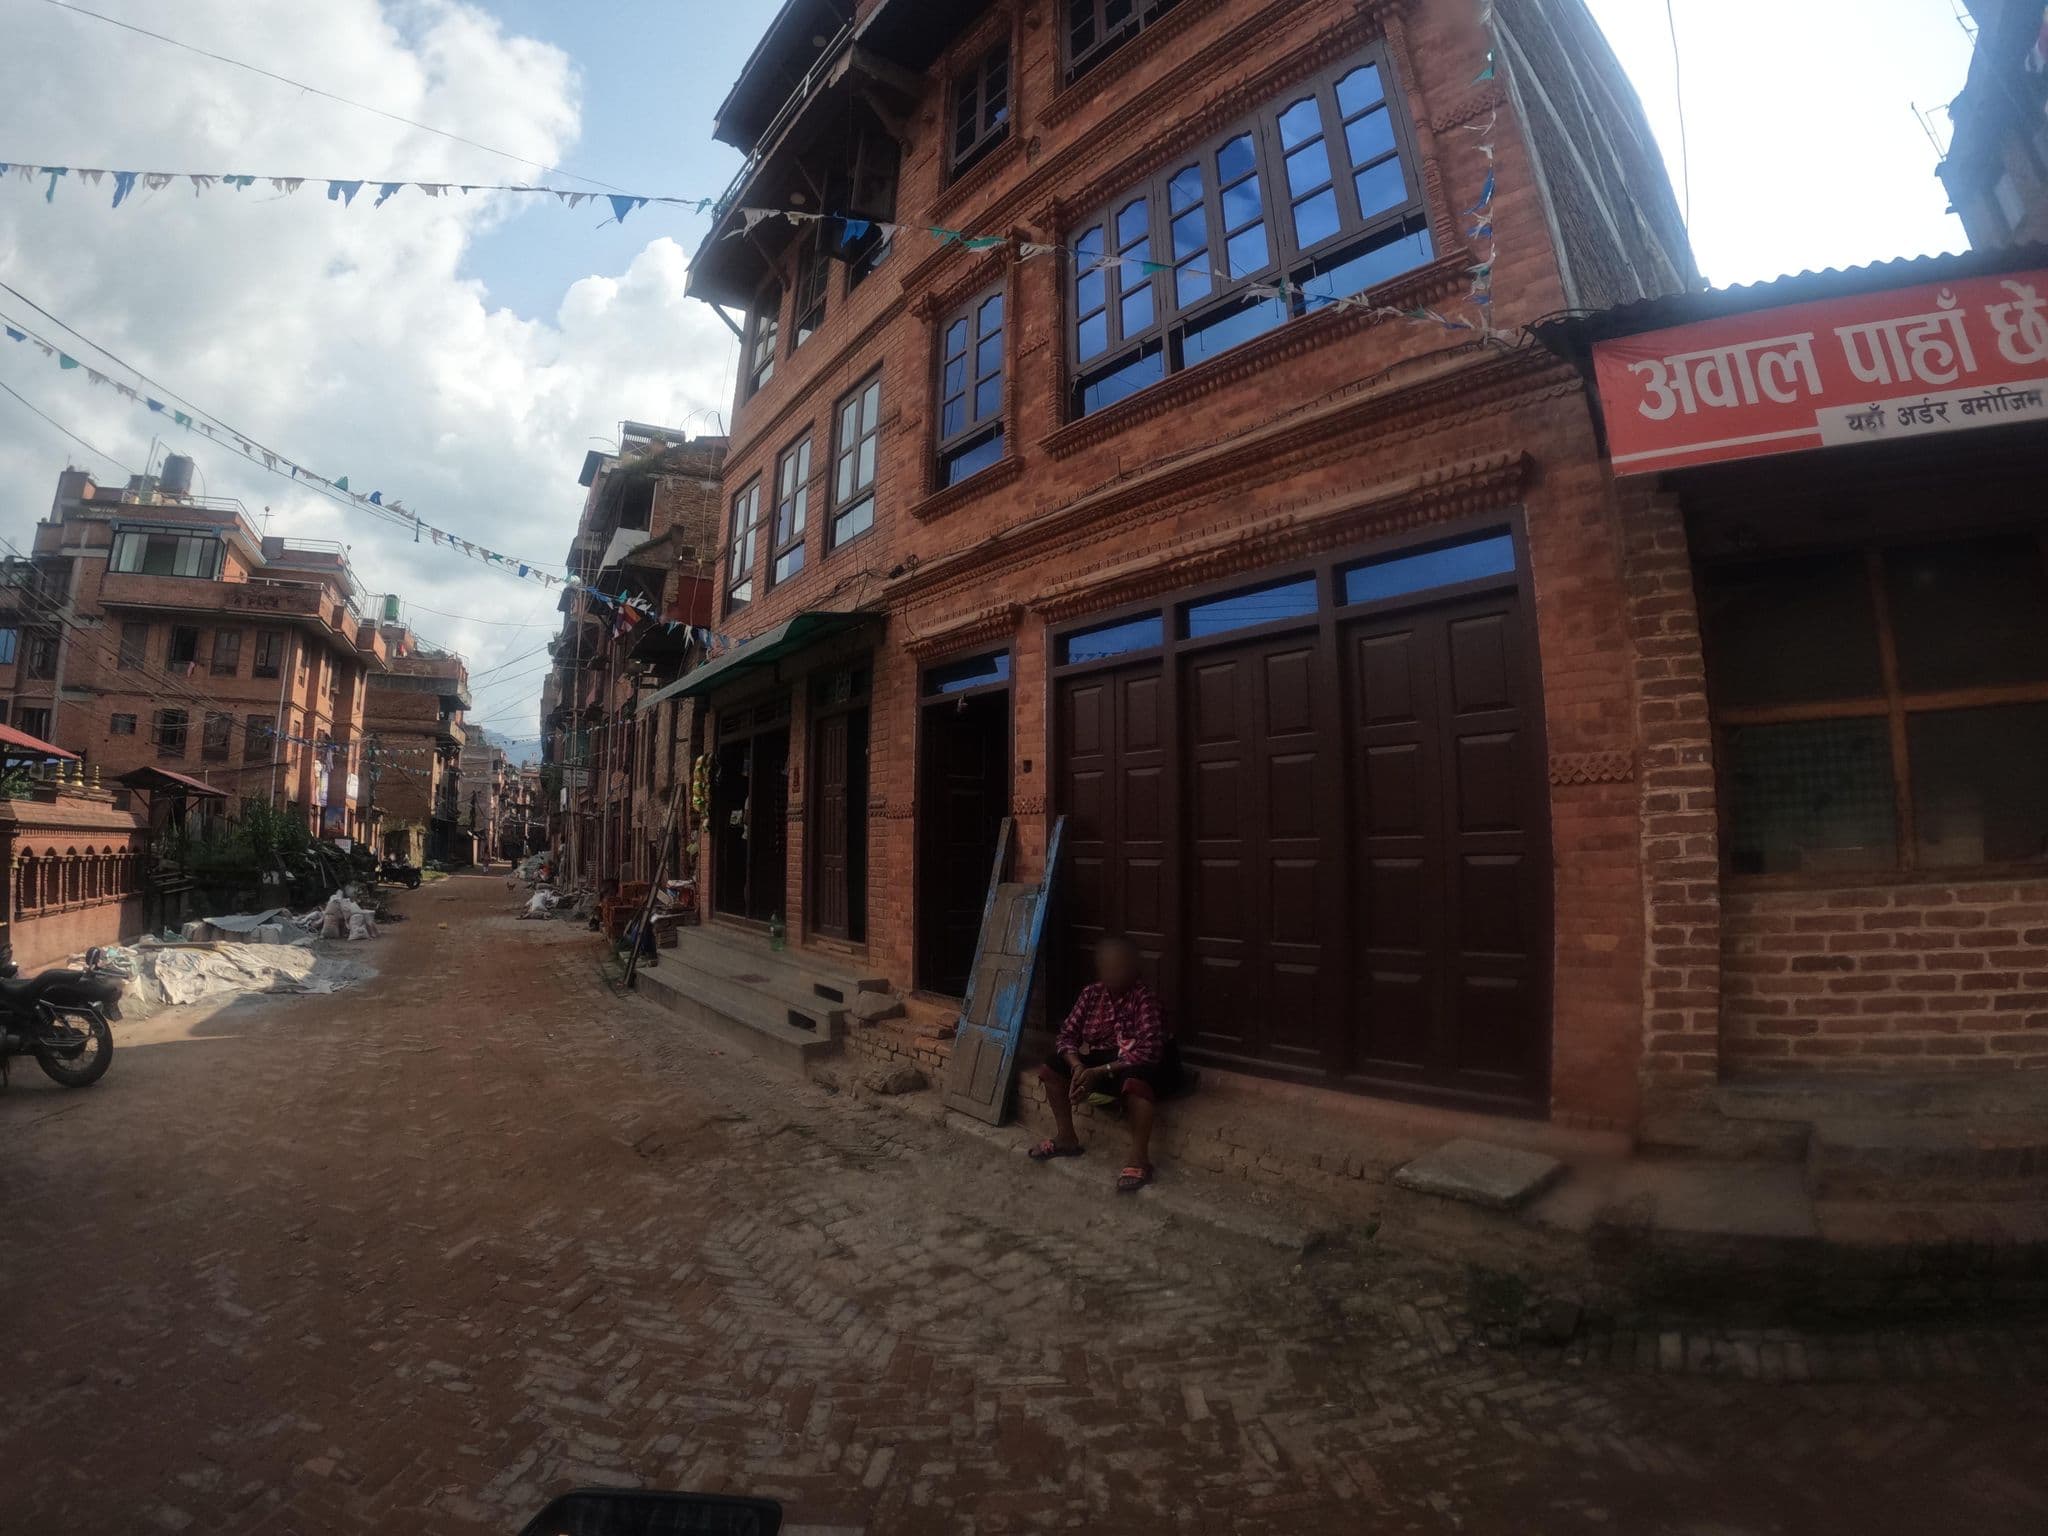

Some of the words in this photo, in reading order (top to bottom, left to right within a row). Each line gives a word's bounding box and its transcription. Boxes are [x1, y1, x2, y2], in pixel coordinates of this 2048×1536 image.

[1627, 333, 1823, 420] अवाल
[1846, 403, 1885, 431] यहाँ
[1897, 398, 1951, 426] अर्डर
